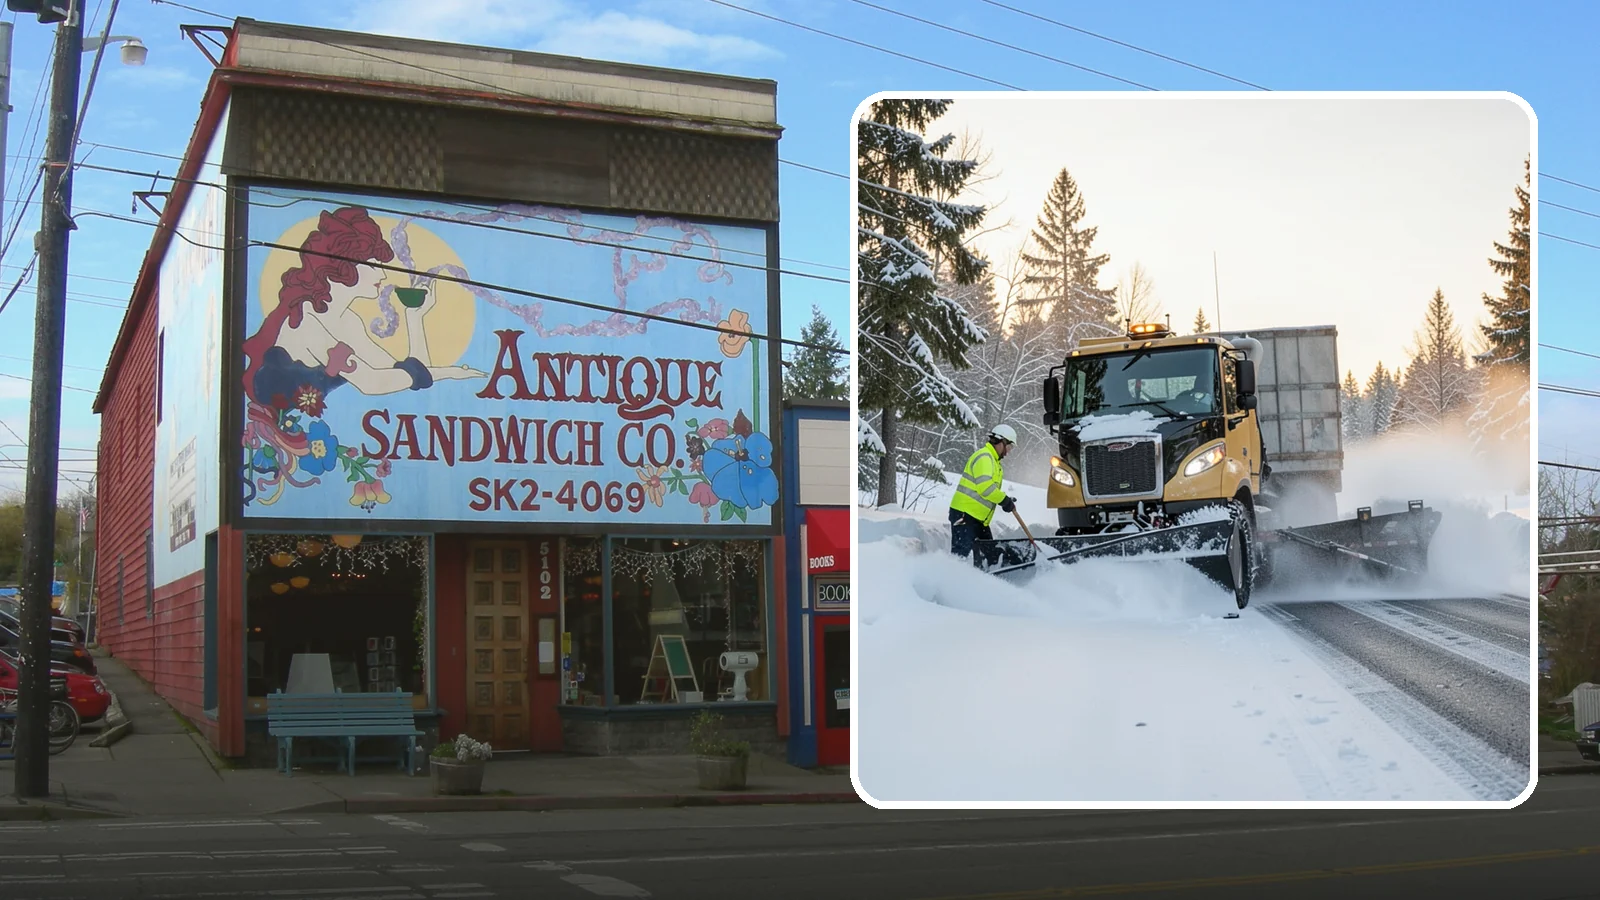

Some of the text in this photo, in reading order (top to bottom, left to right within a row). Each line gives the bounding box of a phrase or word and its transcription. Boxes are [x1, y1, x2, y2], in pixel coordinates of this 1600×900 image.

[476, 329, 723, 421] ANTIQUE
[361, 409, 685, 468] SANDWICH CO.
[468, 477, 645, 512] SK2-4069
[540, 542, 551, 600] 5102
[809, 555, 834, 569] BOOKS
